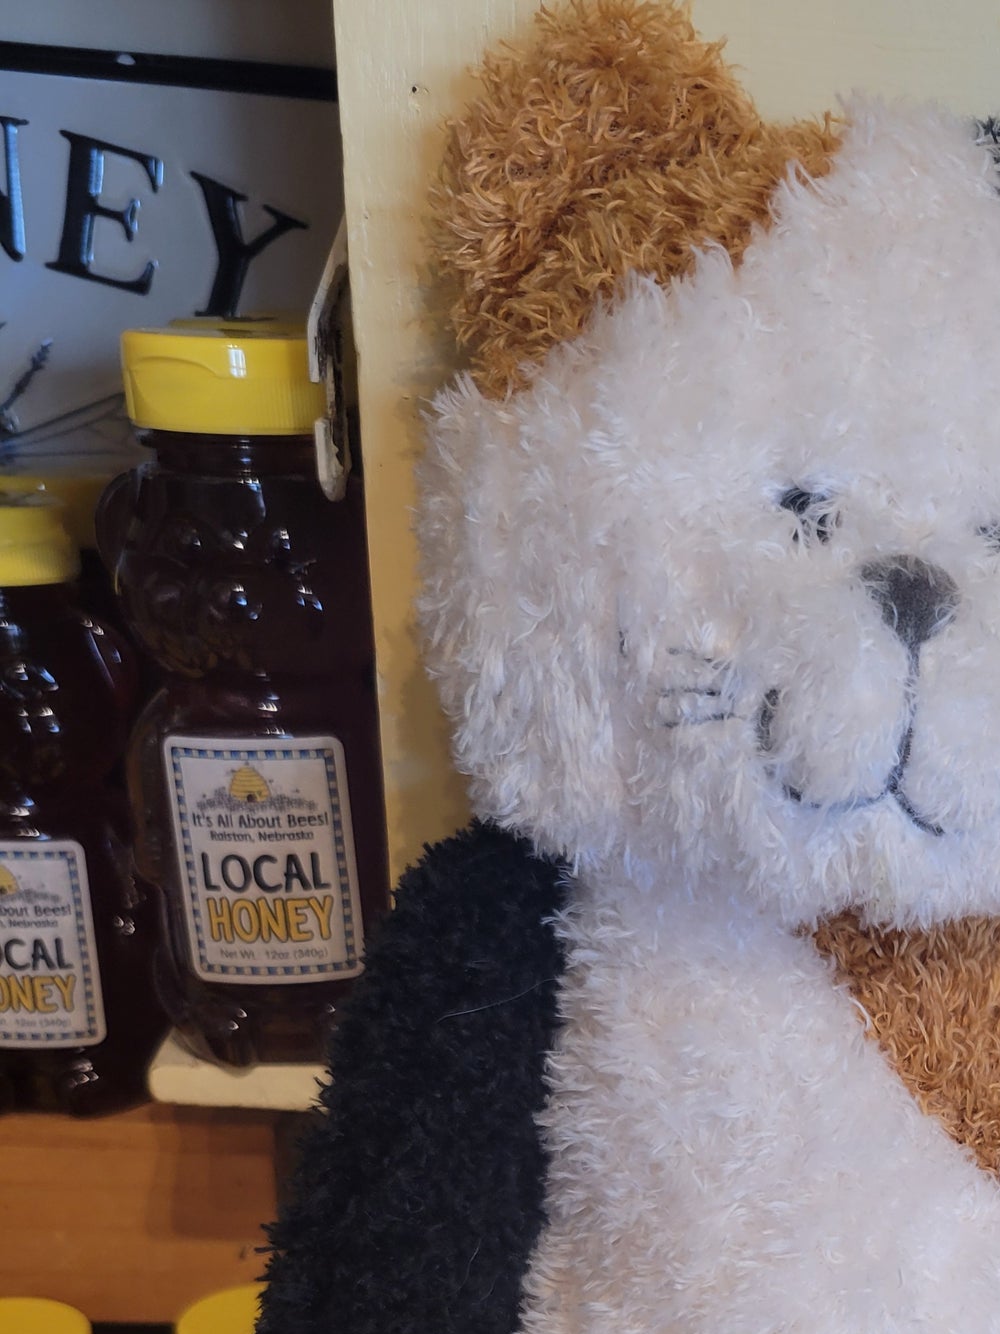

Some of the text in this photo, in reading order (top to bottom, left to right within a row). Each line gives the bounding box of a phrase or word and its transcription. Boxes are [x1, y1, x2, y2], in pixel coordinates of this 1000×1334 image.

[0, 114, 310, 319] EY
[192, 812, 329, 829] It's All About Bees!
[258, 831, 314, 842] Nebraska
[201, 851, 332, 893] LOCAL
[206, 894, 335, 944] HONEY
[0, 937, 74, 971] CAL
